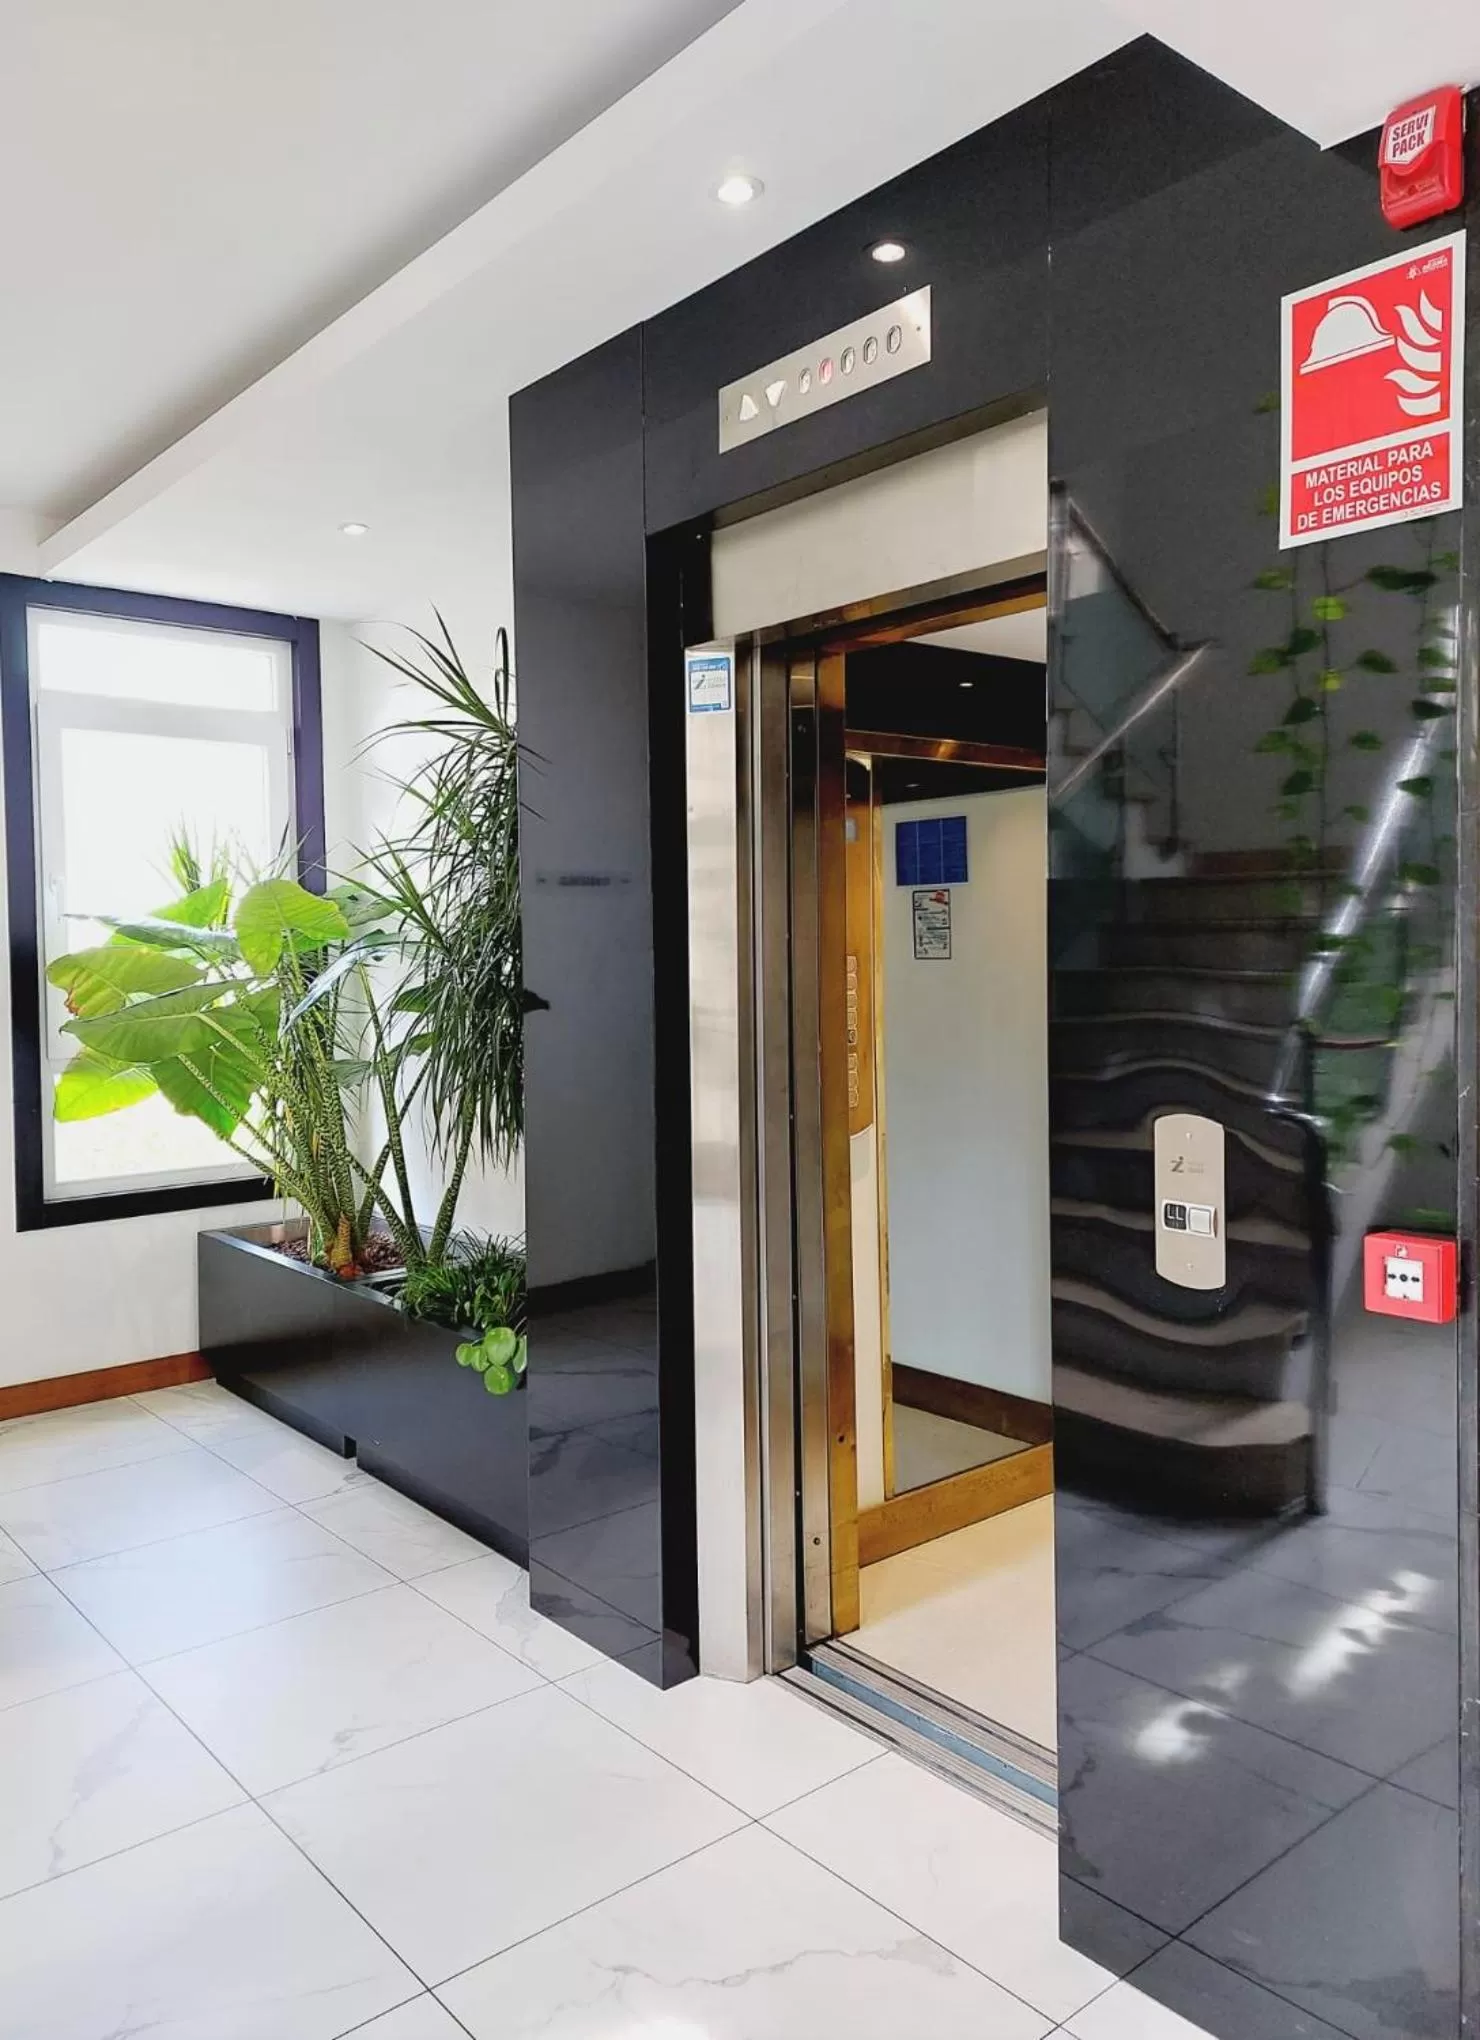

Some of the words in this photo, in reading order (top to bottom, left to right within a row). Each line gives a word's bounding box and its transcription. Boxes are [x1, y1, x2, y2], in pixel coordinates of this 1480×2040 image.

[1392, 113, 1429, 141] SERVI
[1392, 130, 1426, 158] PACK
[1305, 456, 1384, 489] MATERIAL
[1388, 441, 1433, 467] PARA
[1314, 486, 1345, 507] LOS
[1349, 465, 1423, 498] EQUIPOS
[1297, 513, 1319, 531] DE
[1322, 481, 1442, 525] EMERGENCIAS
